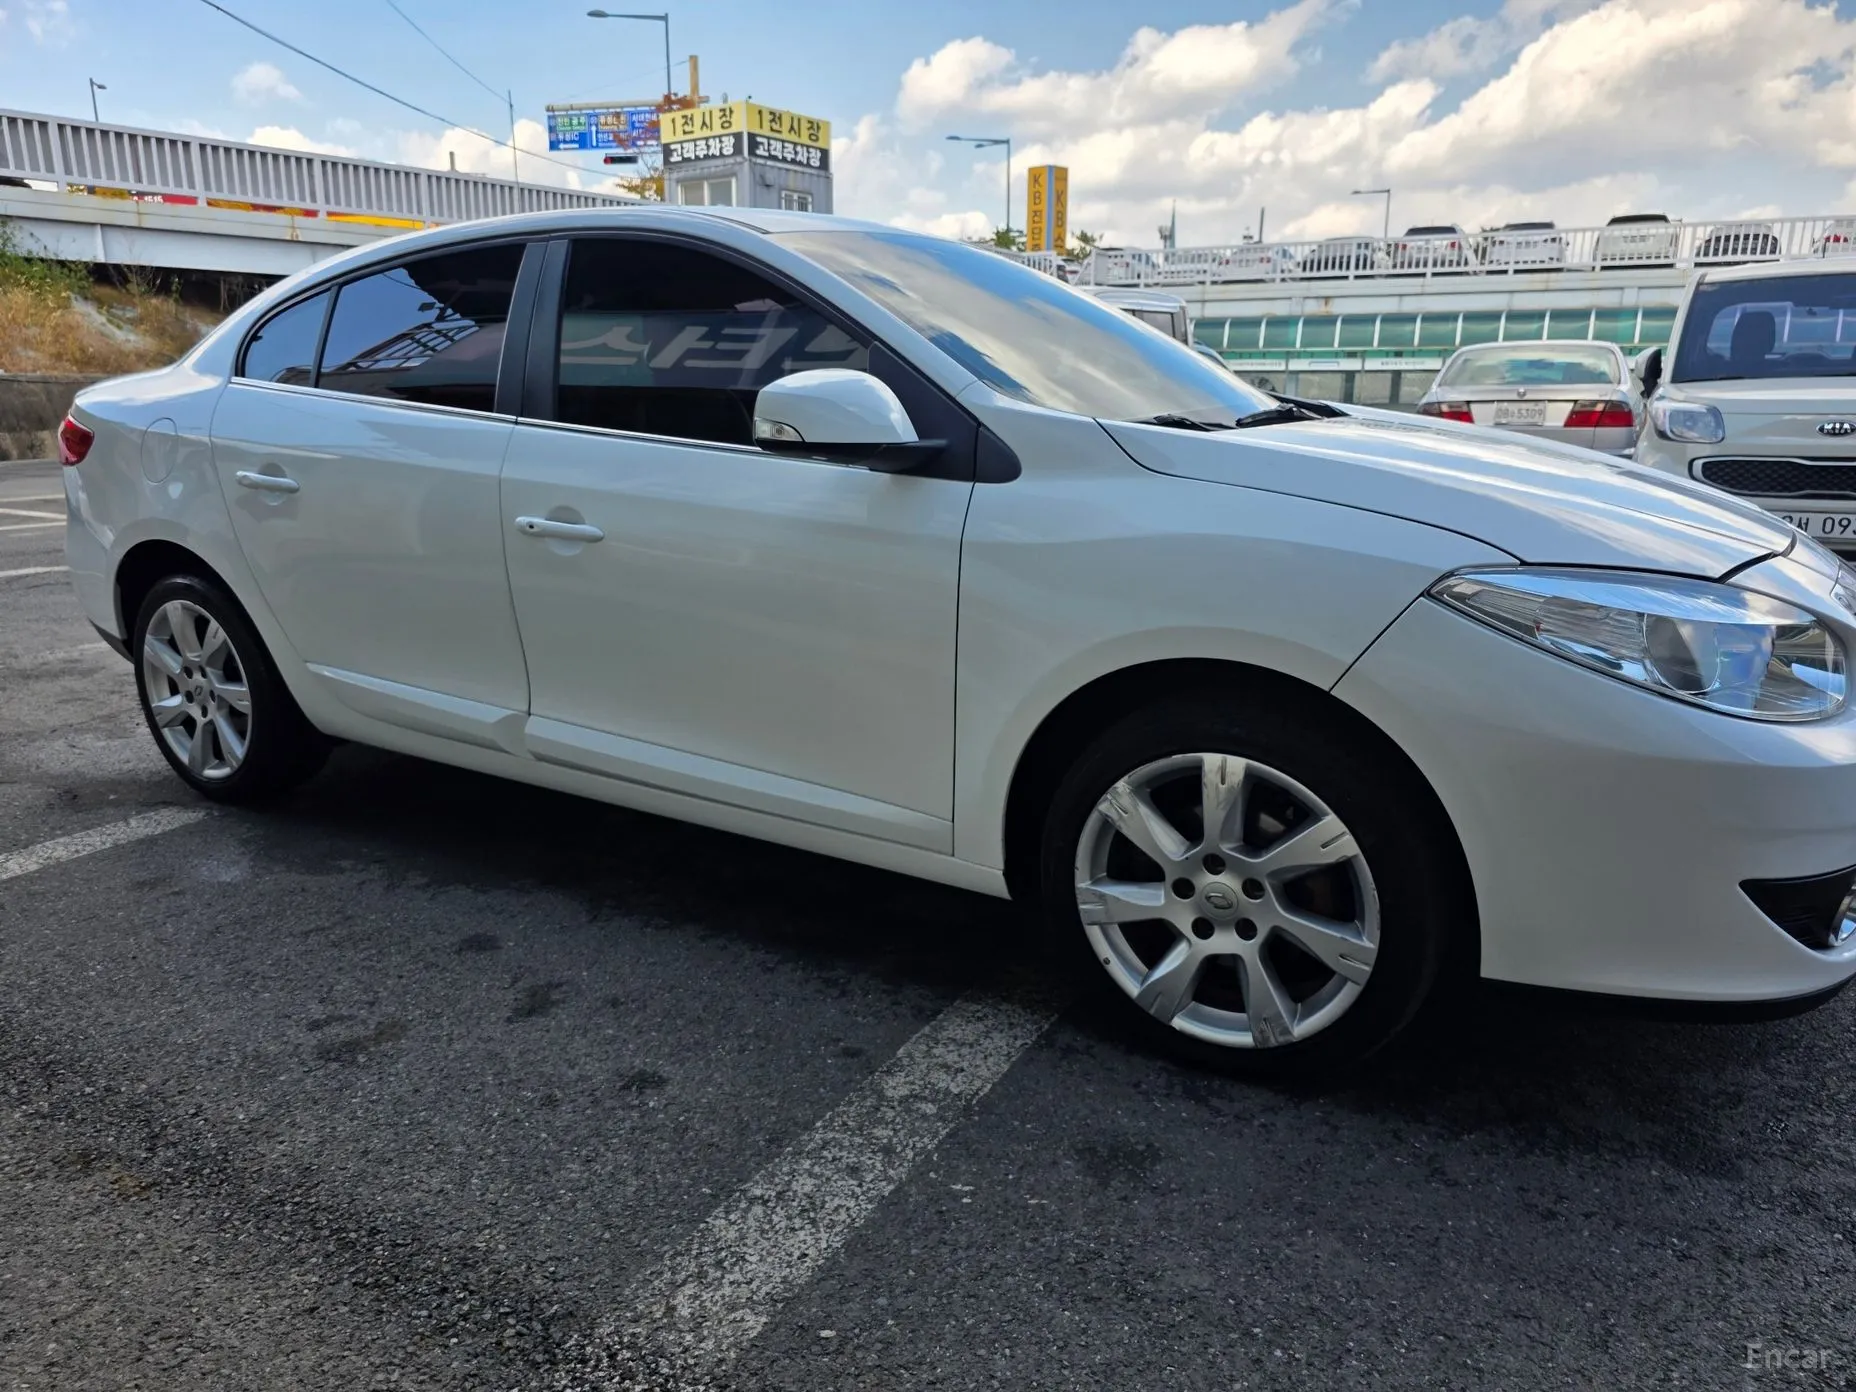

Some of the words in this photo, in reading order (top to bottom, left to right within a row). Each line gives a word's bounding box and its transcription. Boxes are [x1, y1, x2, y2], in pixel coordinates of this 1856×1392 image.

[671, 106, 735, 136] 1전시장
[758, 109, 821, 142] 1전시장
[669, 135, 736, 163] 고객주차장
[755, 136, 822, 167] 고객주차장
[1823, 422, 1851, 434] KIA
[1821, 515, 1856, 536] 09
